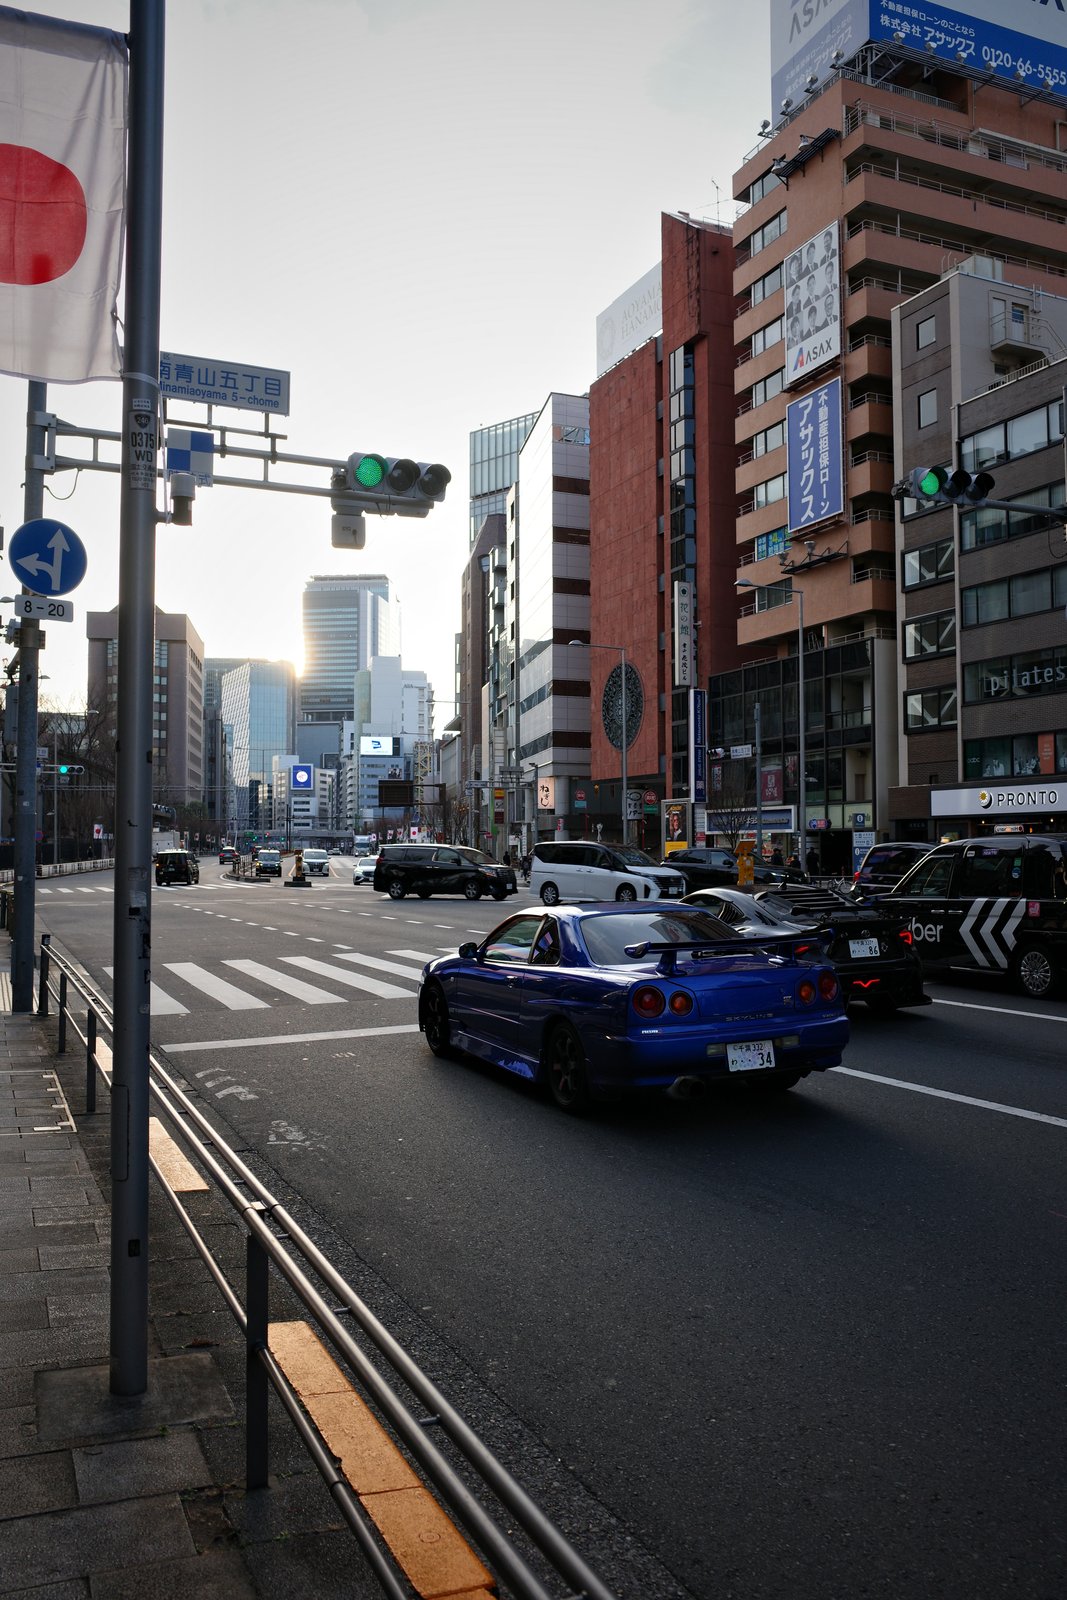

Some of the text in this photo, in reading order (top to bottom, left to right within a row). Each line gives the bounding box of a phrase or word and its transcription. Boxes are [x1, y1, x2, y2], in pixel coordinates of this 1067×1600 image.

[880, 14, 1067, 86] 株式会社 アサックス 0120-66-5555
[131, 431, 155, 449] 0375
[818, 389, 830, 514] 不動産担保ローン
[798, 397, 815, 522] アサックス
[990, 665, 1066, 696] pilates
[997, 790, 1059, 808] PRONTO
[908, 917, 944, 943] ber
